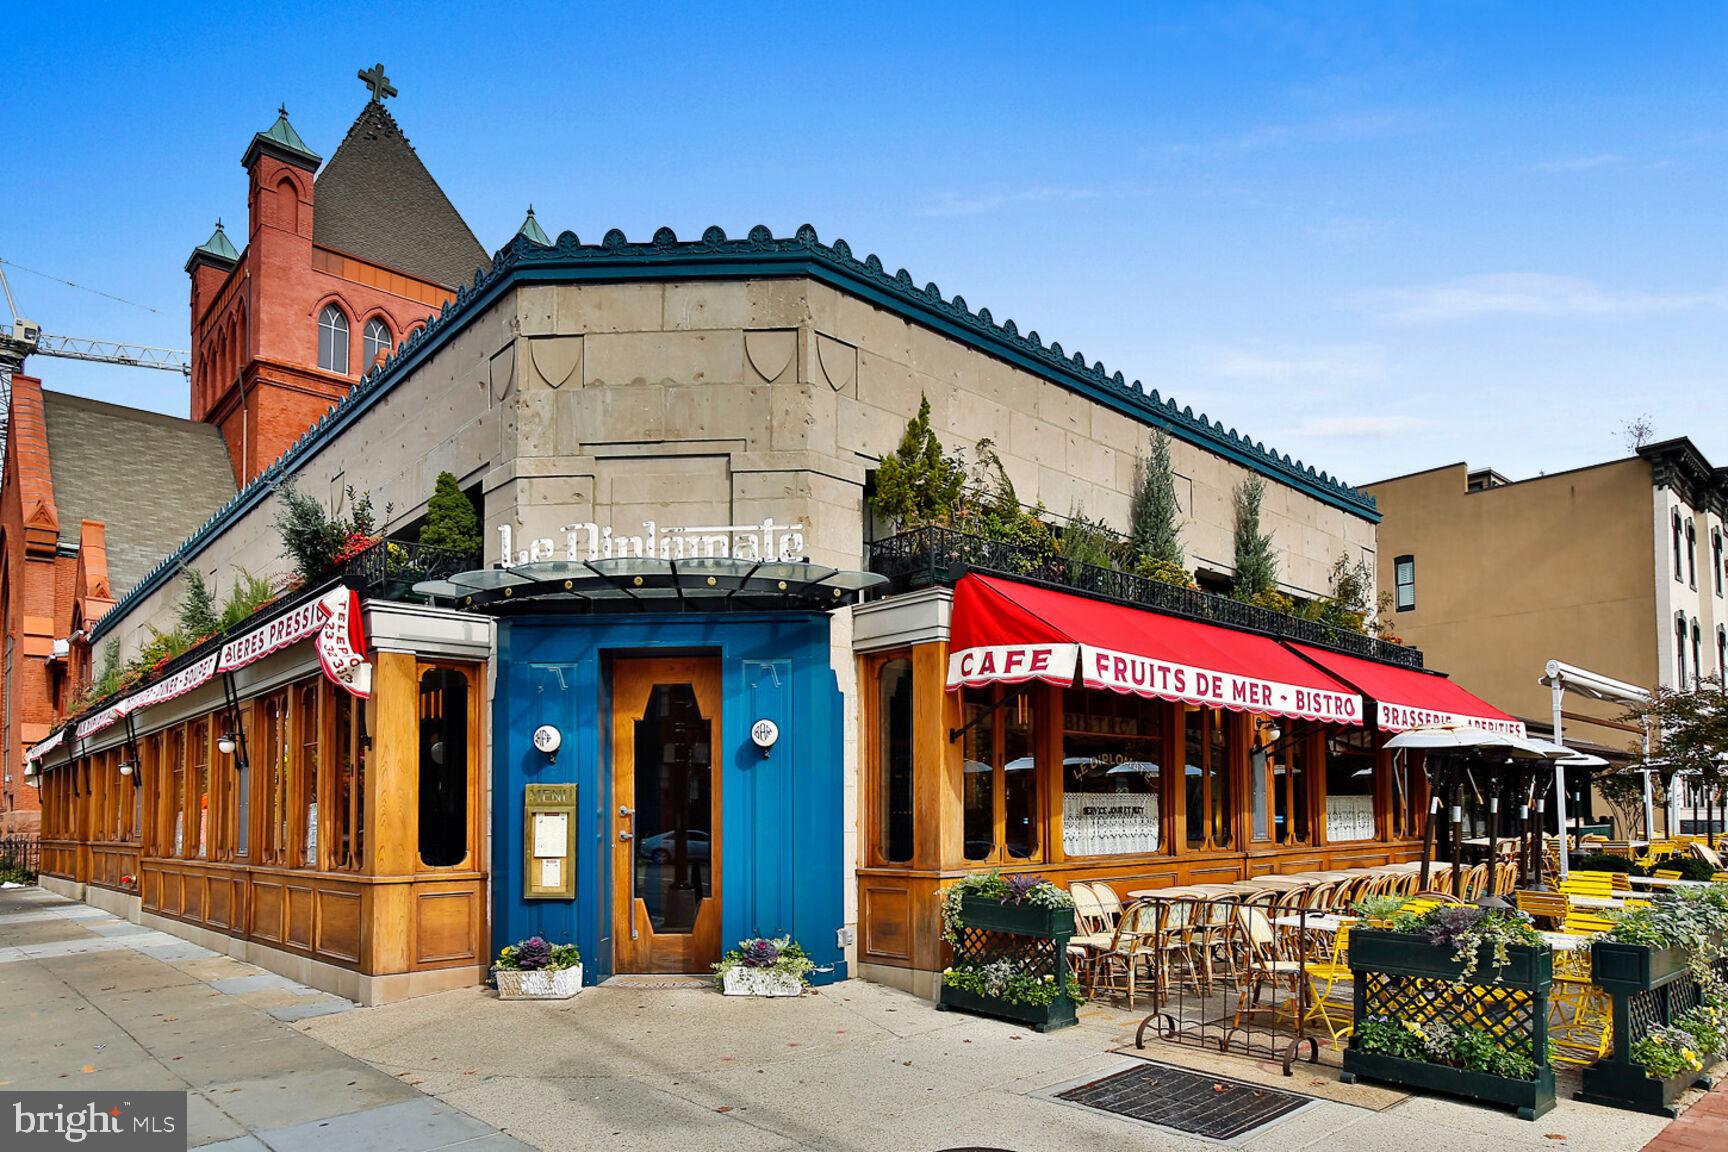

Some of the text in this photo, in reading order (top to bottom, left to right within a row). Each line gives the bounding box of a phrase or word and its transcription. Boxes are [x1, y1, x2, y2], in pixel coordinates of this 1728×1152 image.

[499, 524, 554, 568] Le
[269, 604, 326, 645] PRESSIO
[961, 649, 1052, 677] CAFE
[1096, 652, 1186, 694] FRUITS
[1196, 672, 1223, 699] DE
[1232, 679, 1272, 706] MER
[1295, 690, 1355, 716] BISTRO
[528, 788, 573, 803] MENU
